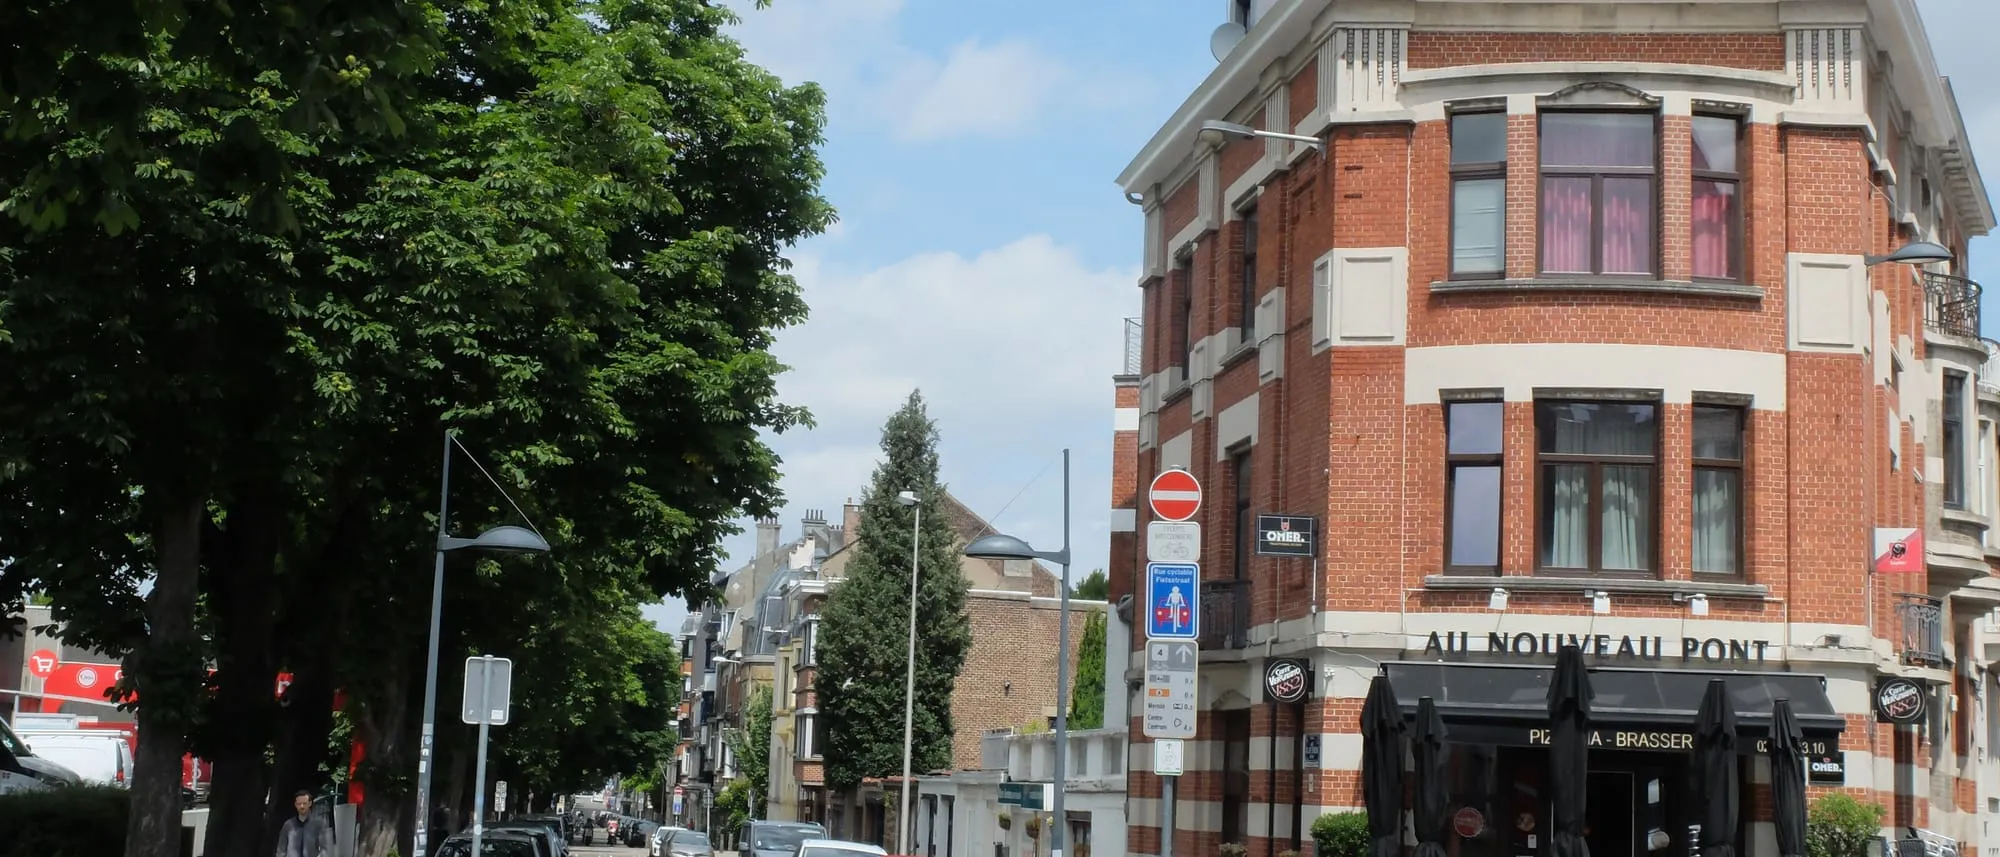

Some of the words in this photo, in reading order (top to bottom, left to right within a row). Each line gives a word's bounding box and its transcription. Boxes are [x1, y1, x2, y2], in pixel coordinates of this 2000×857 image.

[1167, 568, 1193, 576] cyclable
[1157, 649, 1163, 657] 4
[1424, 631, 1468, 656] AU
[1488, 632, 1662, 661] NOUVEAU
[1682, 637, 1769, 665] PONT
[1529, 729, 1602, 746] PIZIA
[1616, 732, 1693, 749] BRASSER
